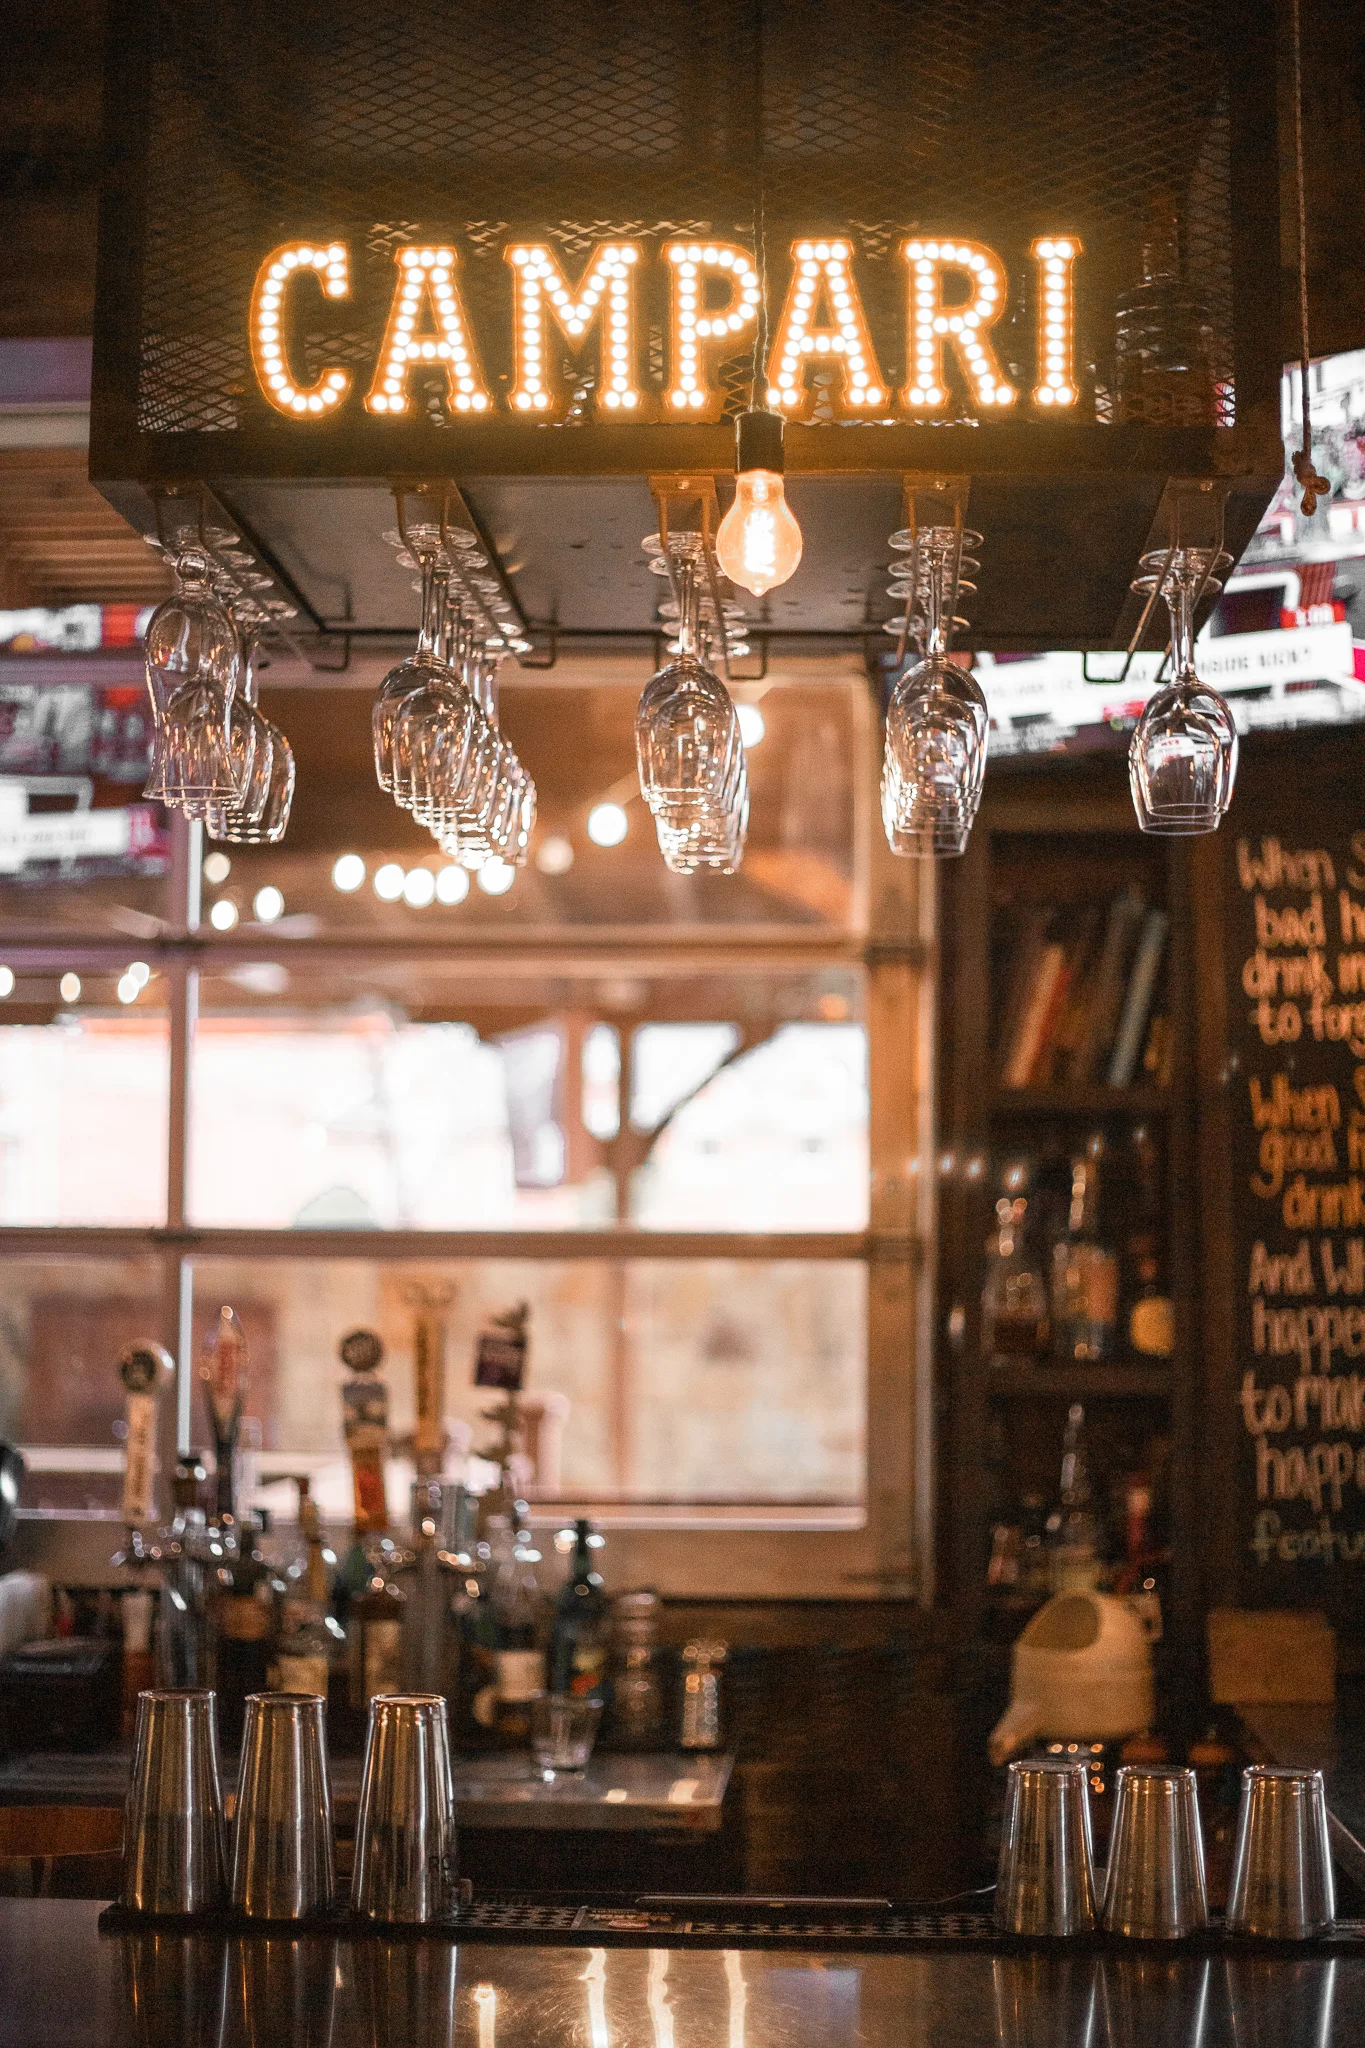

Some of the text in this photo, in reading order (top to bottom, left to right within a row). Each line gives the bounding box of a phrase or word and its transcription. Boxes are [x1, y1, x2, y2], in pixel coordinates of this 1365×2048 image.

[248, 236, 1083, 419] CAMPARI
[1236, 837, 1336, 891] When
[1255, 893, 1327, 948] bad
[1242, 946, 1333, 1000] drink
[1250, 997, 1302, 1046] to
[1249, 1073, 1341, 1130] When
[1250, 1129, 1338, 1200] good
[1248, 1239, 1316, 1295] And
[1240, 1369, 1294, 1436] to
